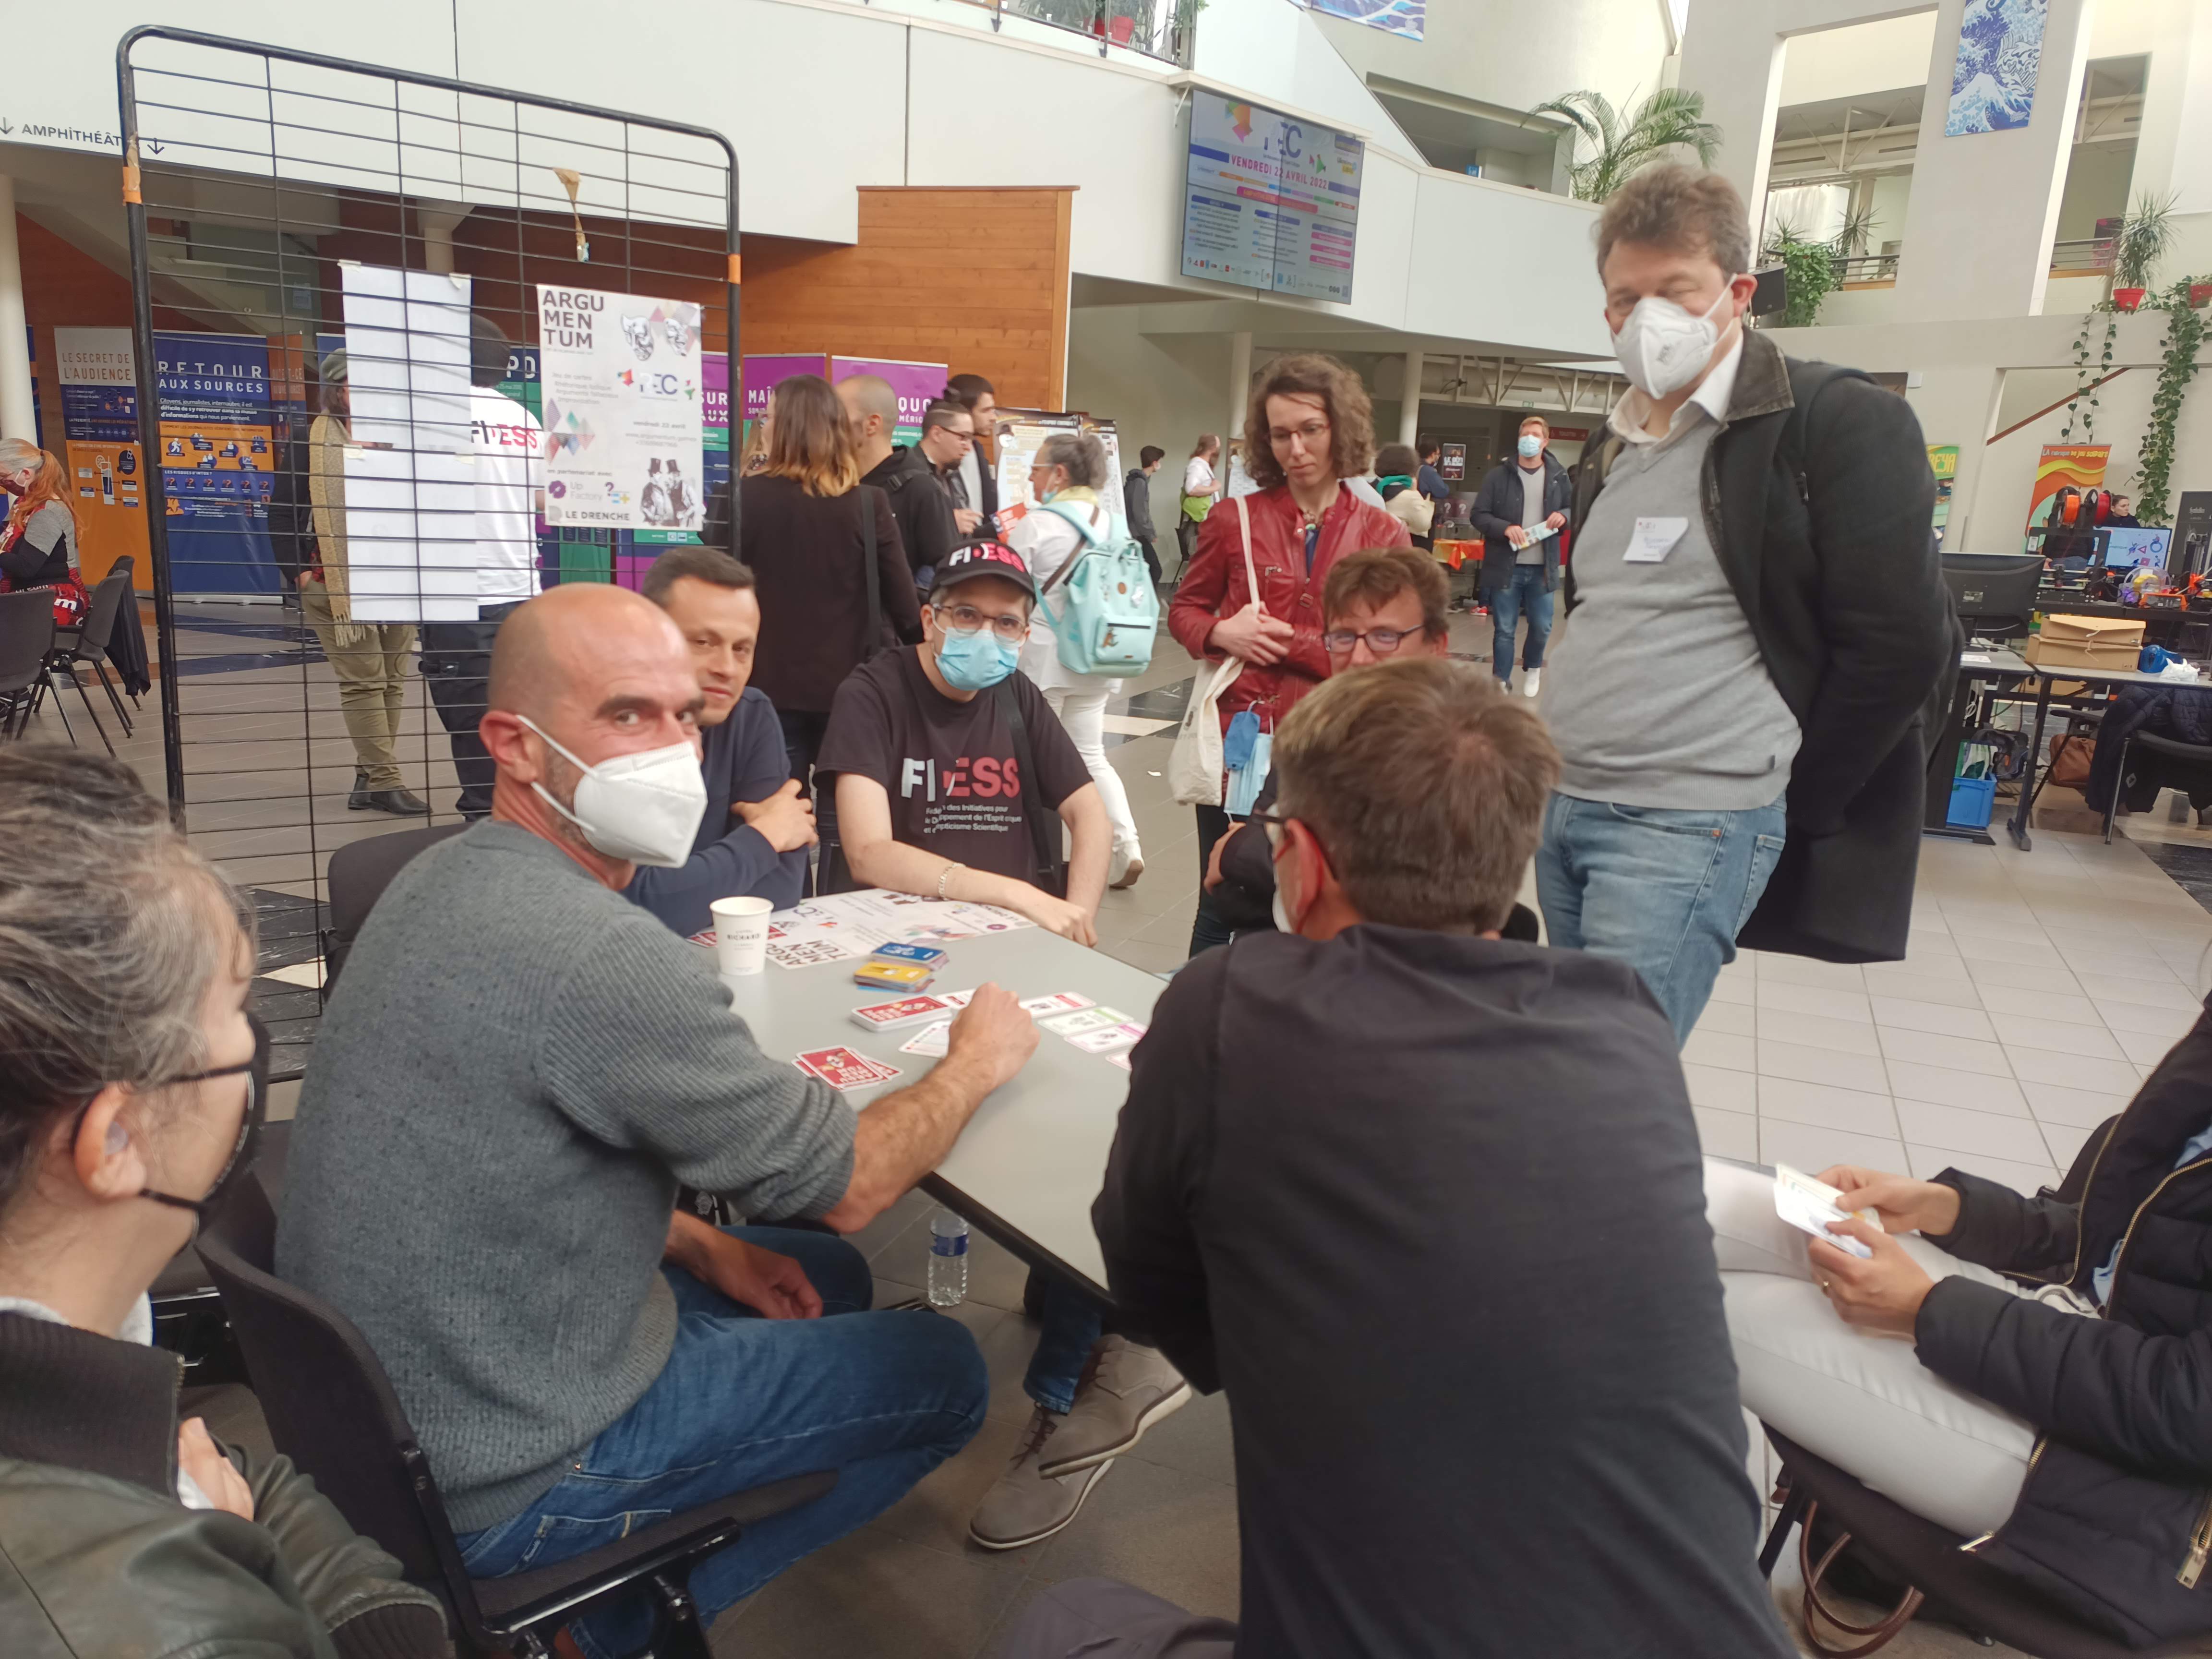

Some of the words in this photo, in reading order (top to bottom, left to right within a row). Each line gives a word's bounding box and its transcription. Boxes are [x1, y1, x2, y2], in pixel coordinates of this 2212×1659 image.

[1231, 155, 1272, 175] VENDREDI
[1274, 167, 1283, 177] 22
[1286, 171, 1307, 184] AVRIL
[1310, 176, 1327, 189] 2022
[543, 290, 604, 312] ARGU
[544, 309, 592, 330] MEN
[543, 328, 592, 349] TUM
[62, 353, 73, 362] LE
[76, 353, 113, 363] SECRET
[118, 354, 130, 363] DE
[64, 368, 131, 381] L'AUDIENCE
[158, 361, 262, 379] RETOUR
[159, 379, 188, 389] AUX
[194, 380, 264, 393] SOURCES
[570, 481, 583, 491] Up
[570, 491, 603, 502] Factory
[565, 510, 578, 519] LE
[581, 511, 631, 521] DRENCHE
